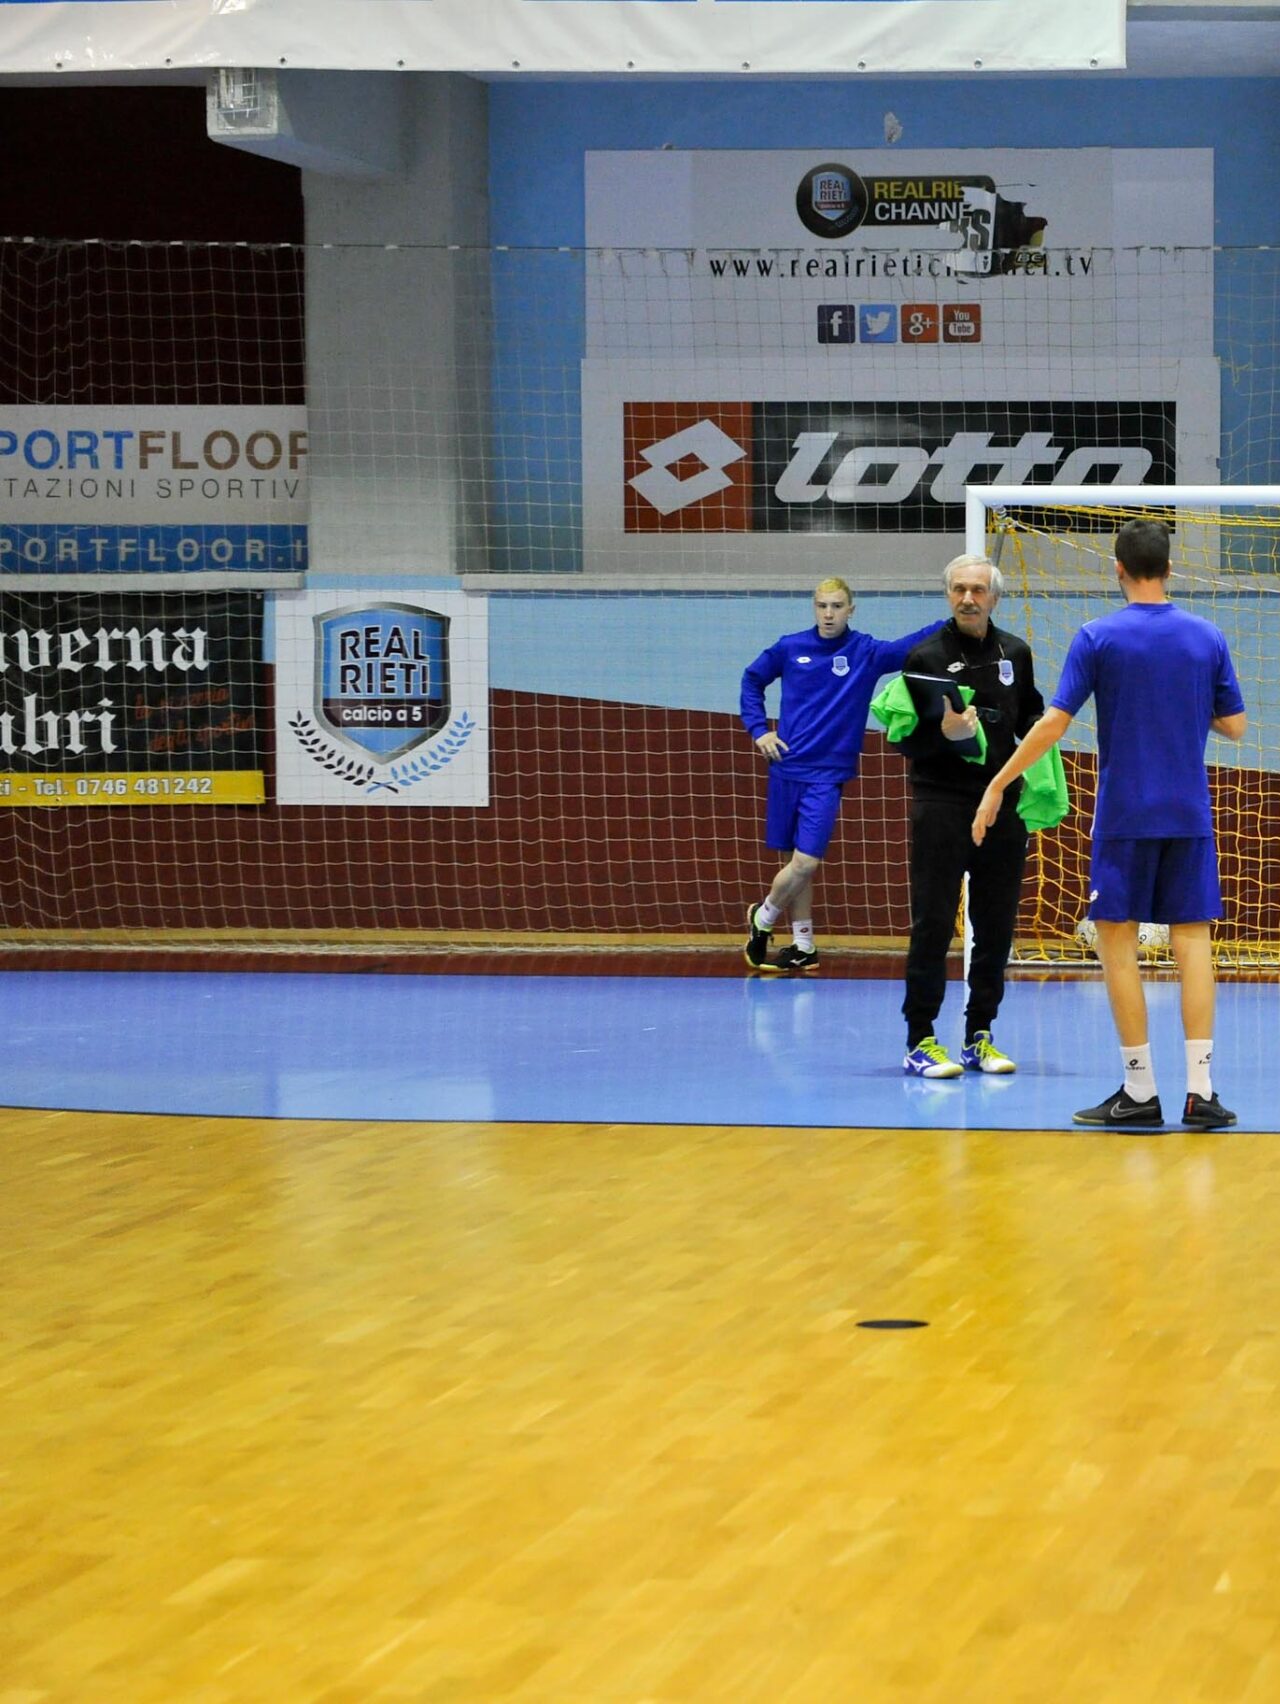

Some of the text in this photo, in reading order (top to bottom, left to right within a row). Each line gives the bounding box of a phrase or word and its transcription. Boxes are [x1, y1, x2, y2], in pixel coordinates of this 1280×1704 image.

[874, 202, 970, 221] CHANNE
[953, 309, 970, 321] You
[4, 478, 300, 499] TAZIONI SPORTIV
[0, 627, 210, 672] verna
[339, 625, 430, 662] REAL
[339, 661, 430, 695] RIETI
[342, 706, 422, 721] calcio a 5
[34, 779, 68, 796] Tel.
[76, 779, 128, 796] 0746
[133, 778, 212, 795] 481242
